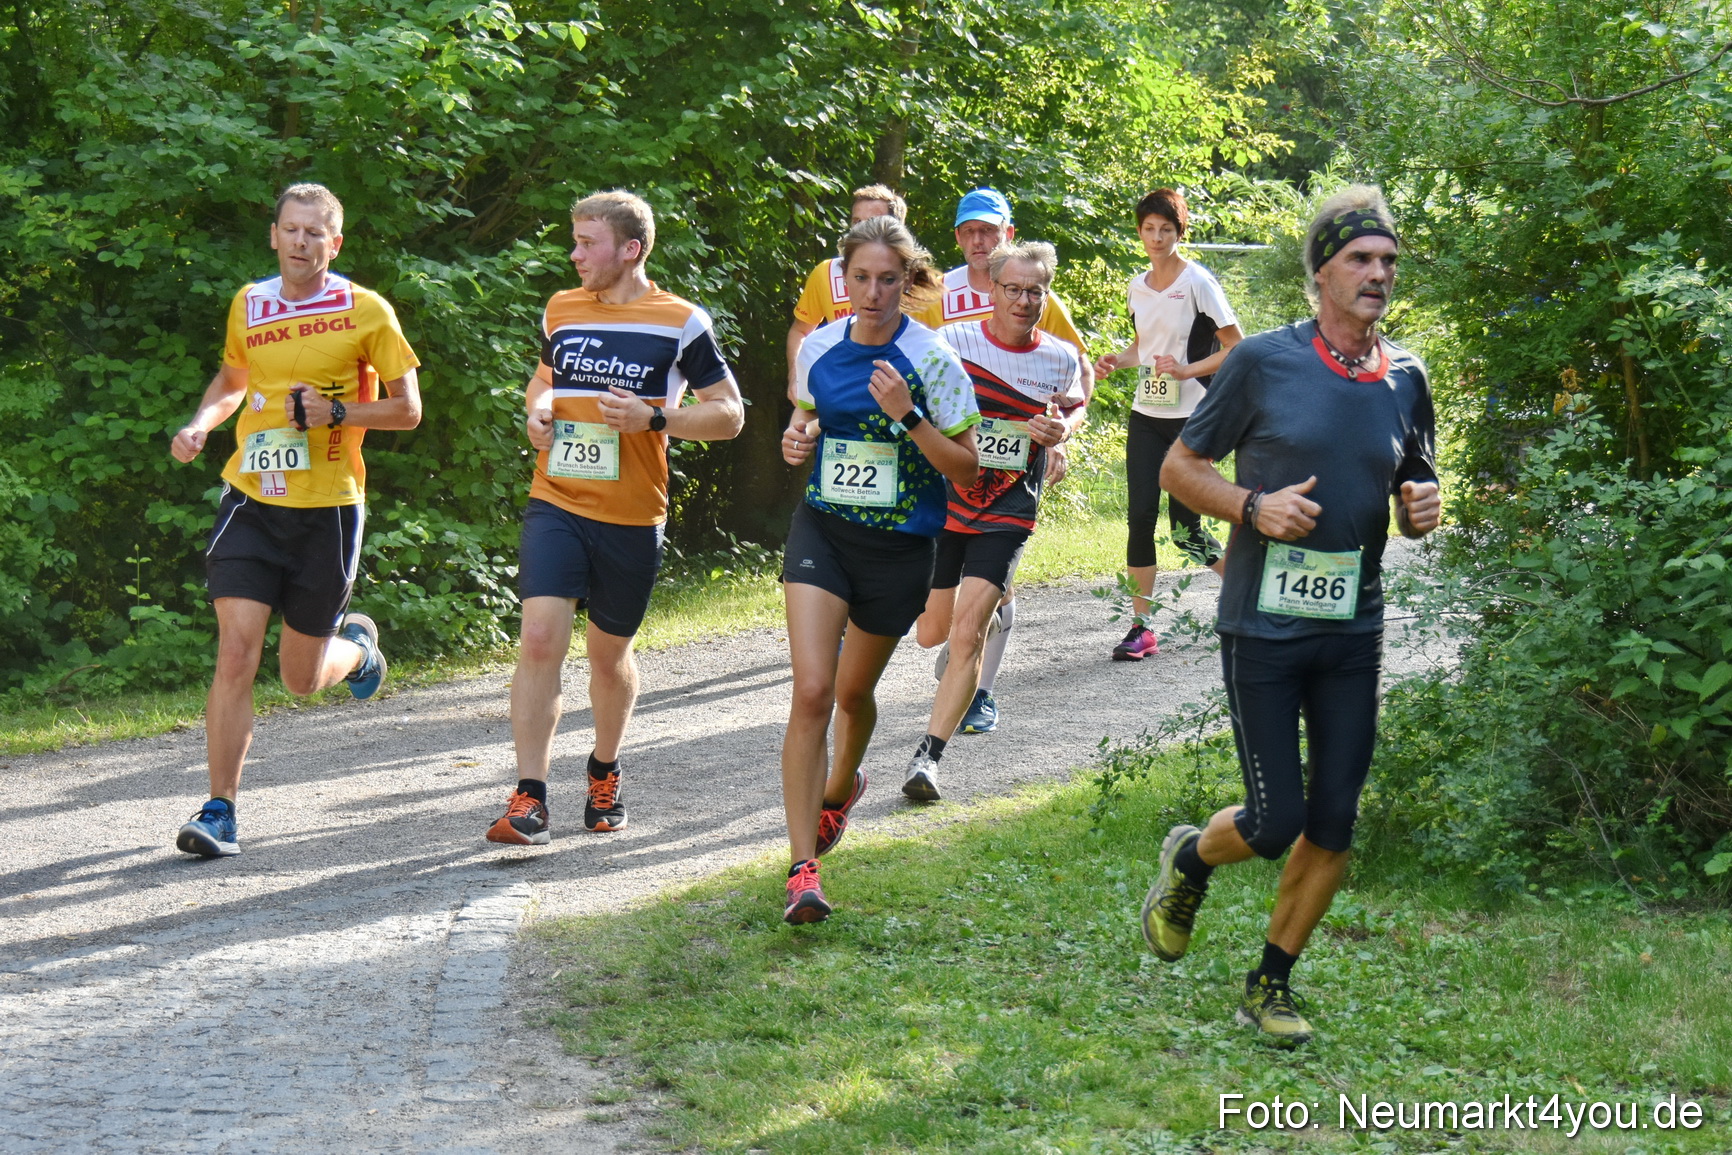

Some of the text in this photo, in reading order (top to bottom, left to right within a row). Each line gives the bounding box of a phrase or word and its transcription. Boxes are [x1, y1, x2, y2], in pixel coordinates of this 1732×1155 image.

[246, 317, 357, 349] MAX BÖGL
[562, 351, 655, 379] Fischer
[570, 373, 644, 389] AUTOMOBILE
[1016, 377, 1053, 392] NEUMARKT
[1144, 380, 1167, 395] 958
[249, 448, 298, 471] 1610
[562, 441, 601, 464] 739
[557, 461, 578, 469] Brunsch
[833, 463, 877, 488] 222
[831, 486, 880, 496] Hollweck Bettina
[1275, 571, 1346, 600] 1486
[1279, 596, 1336, 609] Pfann Wolfgang
